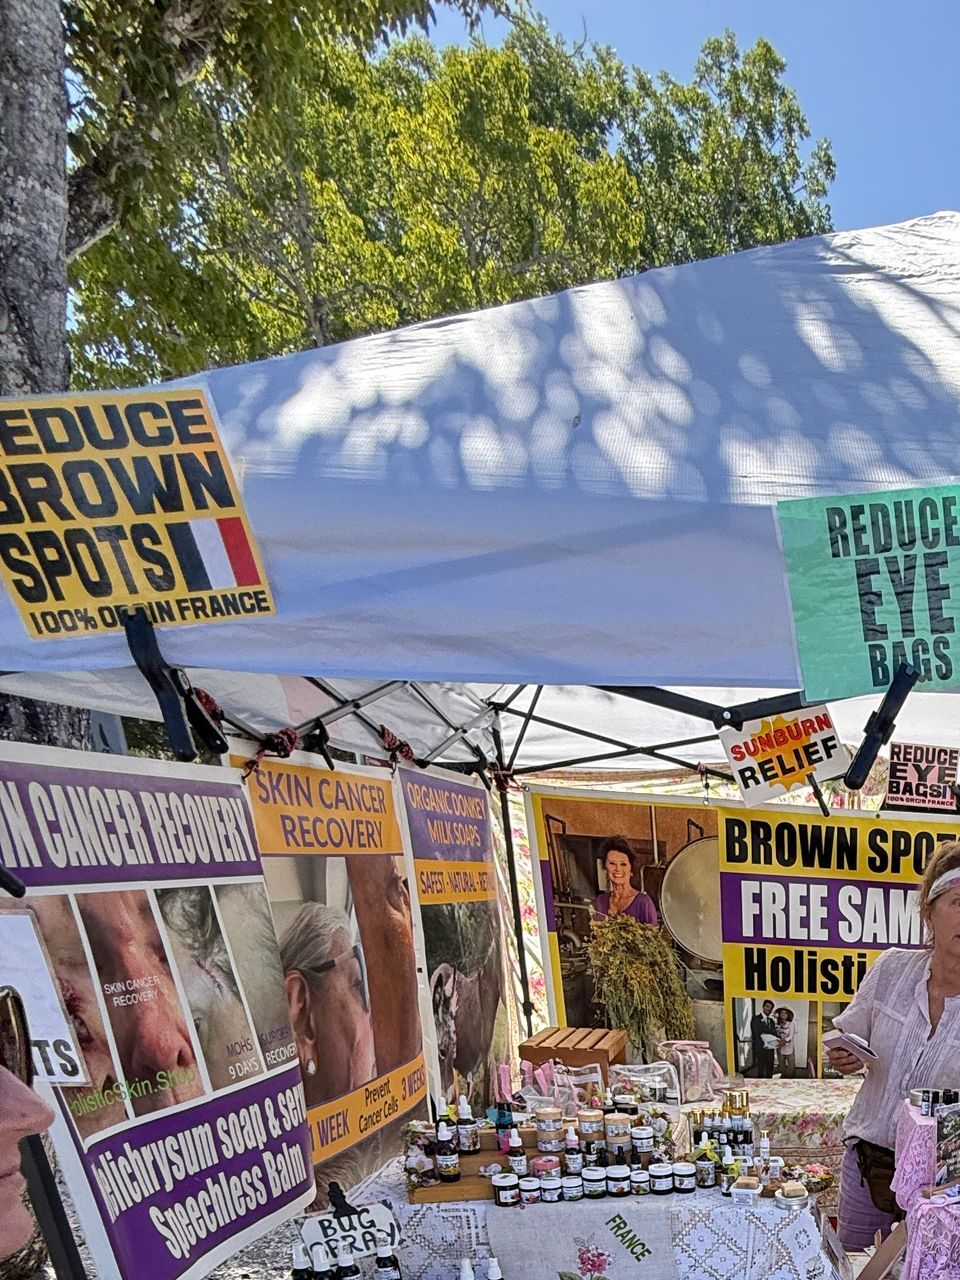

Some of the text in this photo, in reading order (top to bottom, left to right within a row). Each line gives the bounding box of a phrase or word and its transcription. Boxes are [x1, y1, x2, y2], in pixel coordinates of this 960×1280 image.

[0, 399, 215, 456] EDUCE
[826, 496, 960, 558] REDUCE
[0, 523, 176, 604] SPOTS
[30, 608, 98, 634] 100%
[175, 590, 271, 620] FRANCE
[855, 551, 955, 642] EYE
[730, 713, 832, 761] SUNBURN
[890, 744, 959, 767] REDUCE
[737, 735, 838, 790] RELIEF
[889, 762, 958, 784] EYE
[255, 769, 387, 815] SKIN CANCER
[406, 782, 488, 820] ORGANIC DONKEY
[888, 781, 943, 799] BAGS
[28, 781, 154, 868] CANCER
[139, 791, 257, 864] RECOVERY
[279, 814, 384, 849] RECOVERY
[427, 818, 482, 847] MILK SOAPS
[725, 818, 858, 871] BROWN
[420, 871, 446, 894] SAFEST
[448, 871, 477, 893] NATURAL
[741, 880, 829, 941] FREE
[838, 885, 926, 945] SAM
[104, 975, 161, 995] SKIN CANCER
[744, 947, 866, 995] Holisti
[113, 989, 159, 1007] RECOVERY
[226, 1038, 253, 1057] MOHS
[228, 1065, 236, 1079] 9
[235, 1058, 259, 1077] DAYS
[364, 1077, 391, 1107] Prevent
[401, 1077, 407, 1101] 3
[216, 1102, 267, 1160] soap
[264, 1097, 282, 1139] &
[317, 1108, 350, 1148] WEEK
[358, 1094, 399, 1134] Cancer Cells
[149, 1142, 307, 1260] Speechless Balm
[318, 1208, 377, 1239] BUG
[605, 1213, 652, 1262] FRANCE
